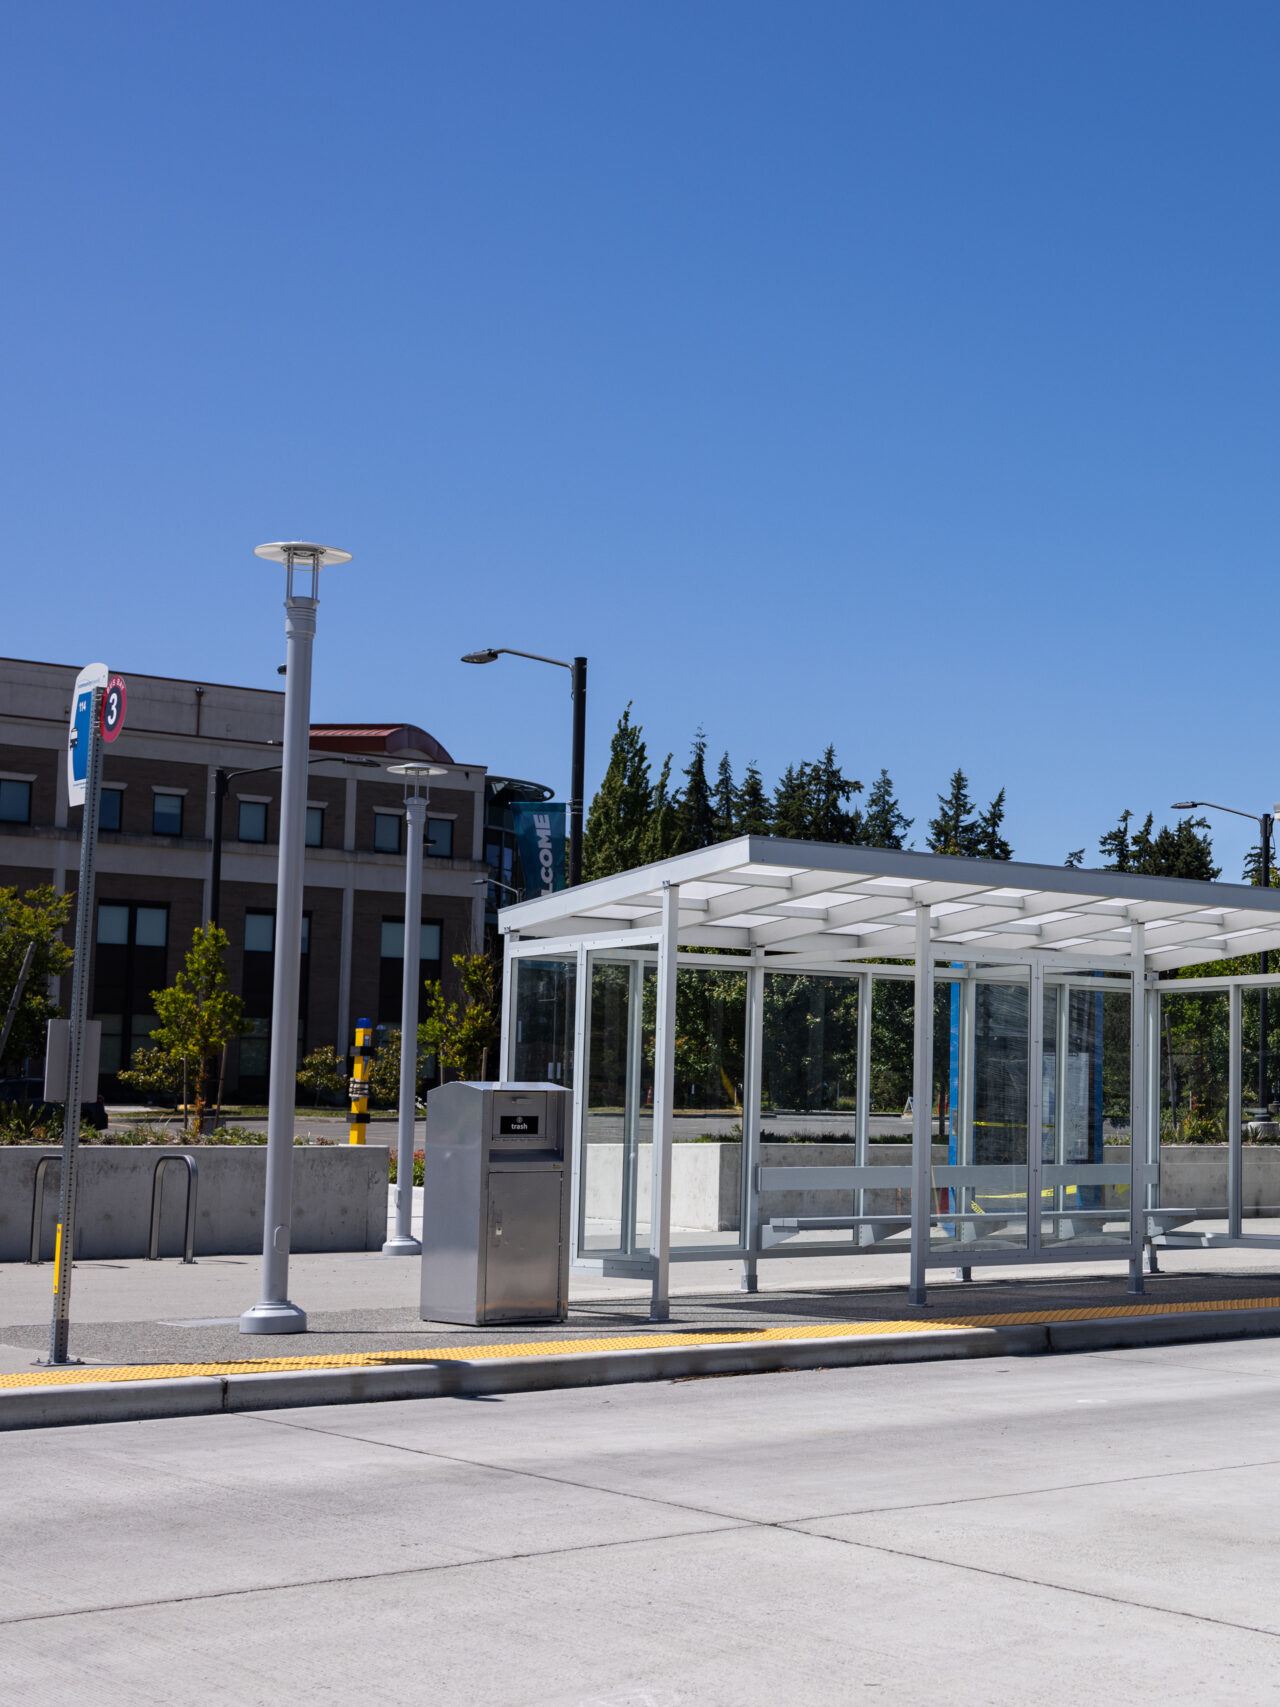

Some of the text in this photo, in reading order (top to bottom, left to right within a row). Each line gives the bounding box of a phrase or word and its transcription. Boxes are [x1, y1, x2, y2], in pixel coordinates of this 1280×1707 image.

[117, 678, 125, 690] BAY
[107, 692, 118, 725] 3
[532, 813, 554, 896] LCOME
[511, 1122, 528, 1130] trash
